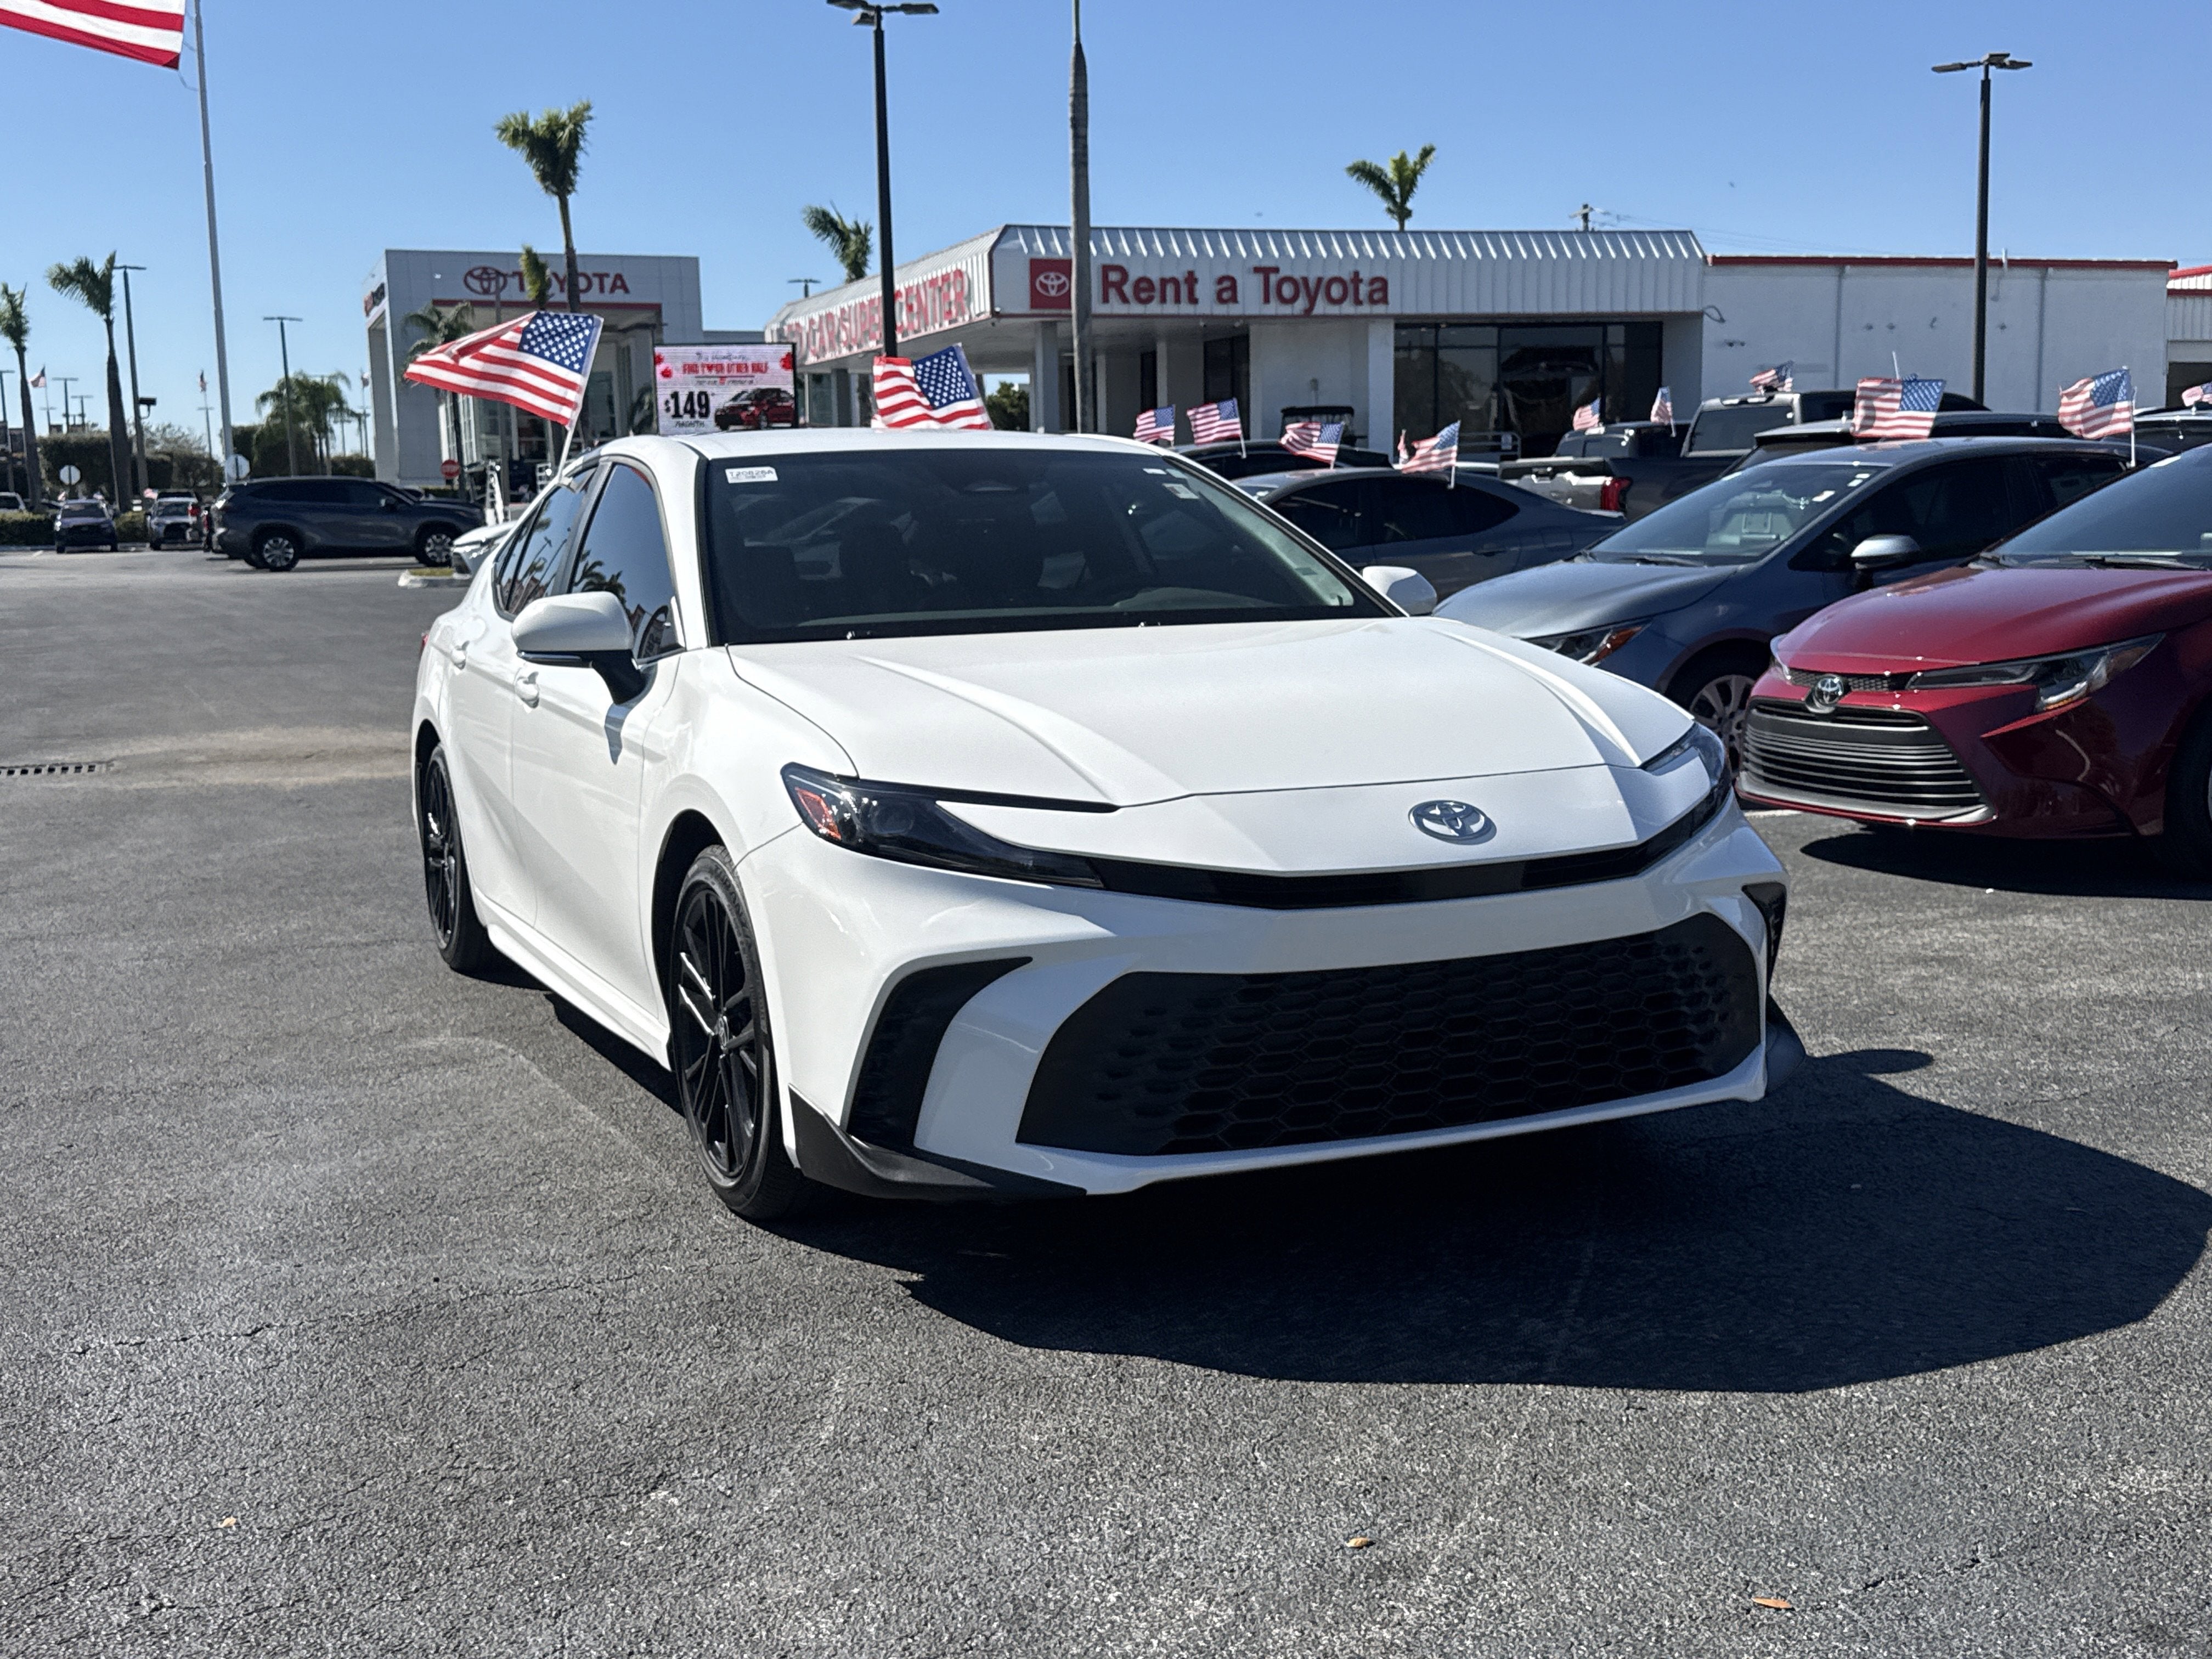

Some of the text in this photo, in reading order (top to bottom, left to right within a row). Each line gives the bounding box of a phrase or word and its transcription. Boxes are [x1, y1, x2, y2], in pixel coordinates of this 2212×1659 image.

[512, 270, 630, 294] TYOTA
[1101, 264, 1389, 316] Rent a Toyota
[808, 311, 837, 357] CAR
[894, 268, 968, 333] CENTER
